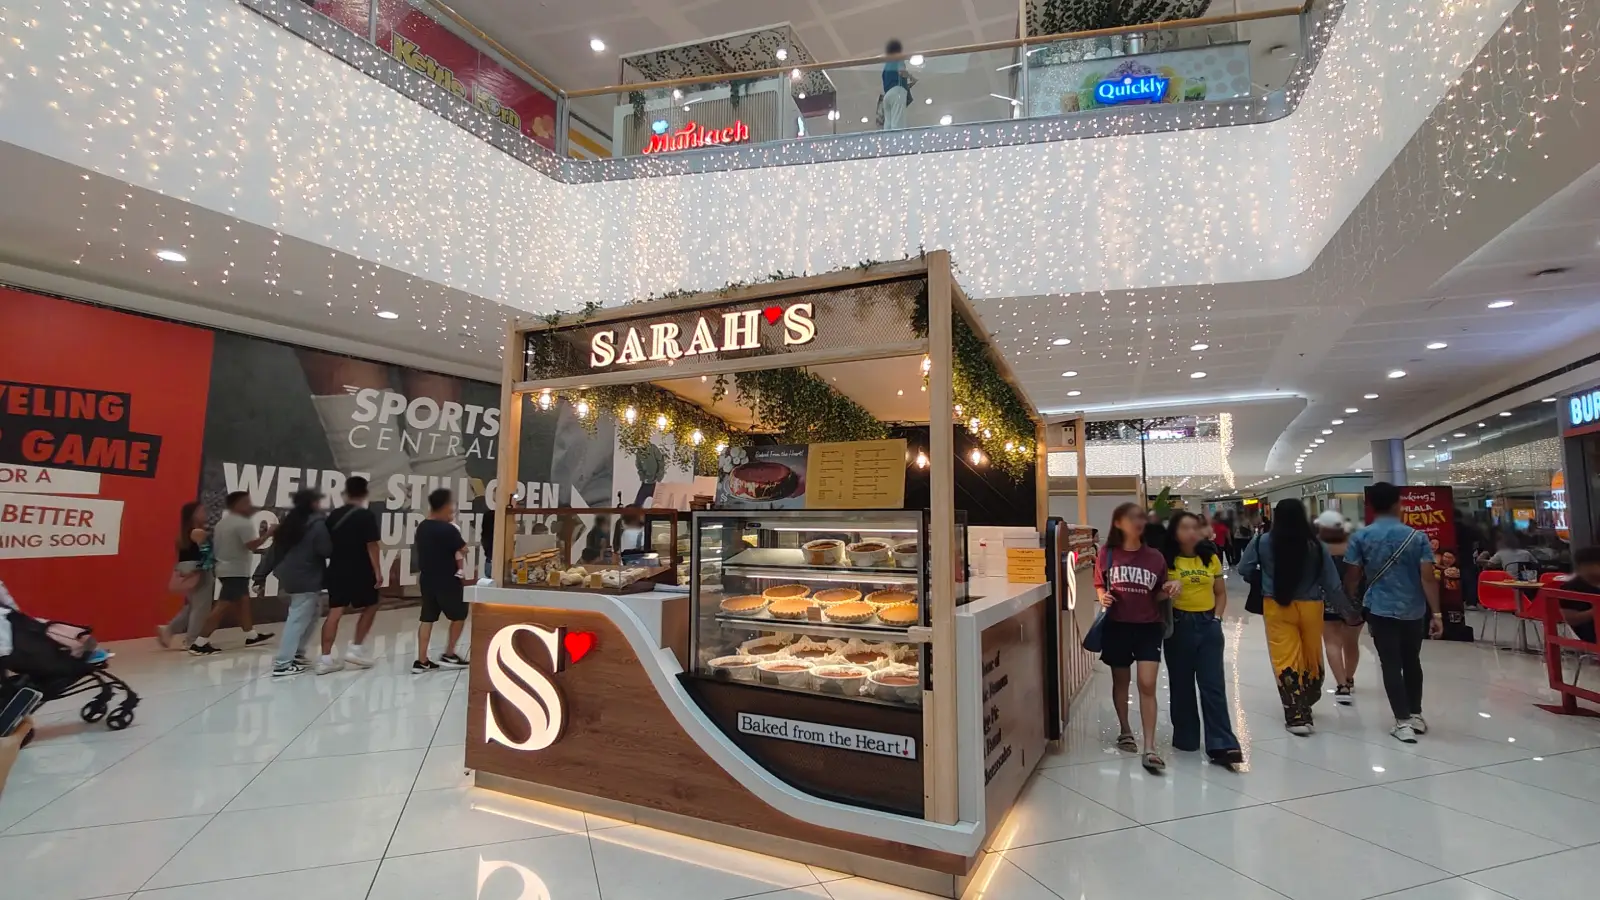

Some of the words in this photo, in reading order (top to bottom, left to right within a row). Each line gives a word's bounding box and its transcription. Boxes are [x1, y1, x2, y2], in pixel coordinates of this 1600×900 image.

[1099, 78, 1165, 97] Quickly
[351, 388, 499, 437] SPORTS
[22, 429, 151, 471] GAME
[348, 424, 496, 460] CENTRAL
[35, 469, 52, 483] A
[1, 504, 94, 528] BETTER
[50, 534, 106, 547] SOON
[485, 624, 562, 751] S
[741, 715, 788, 737] Baked
[793, 725, 825, 743] from
[829, 731, 852, 747] the
